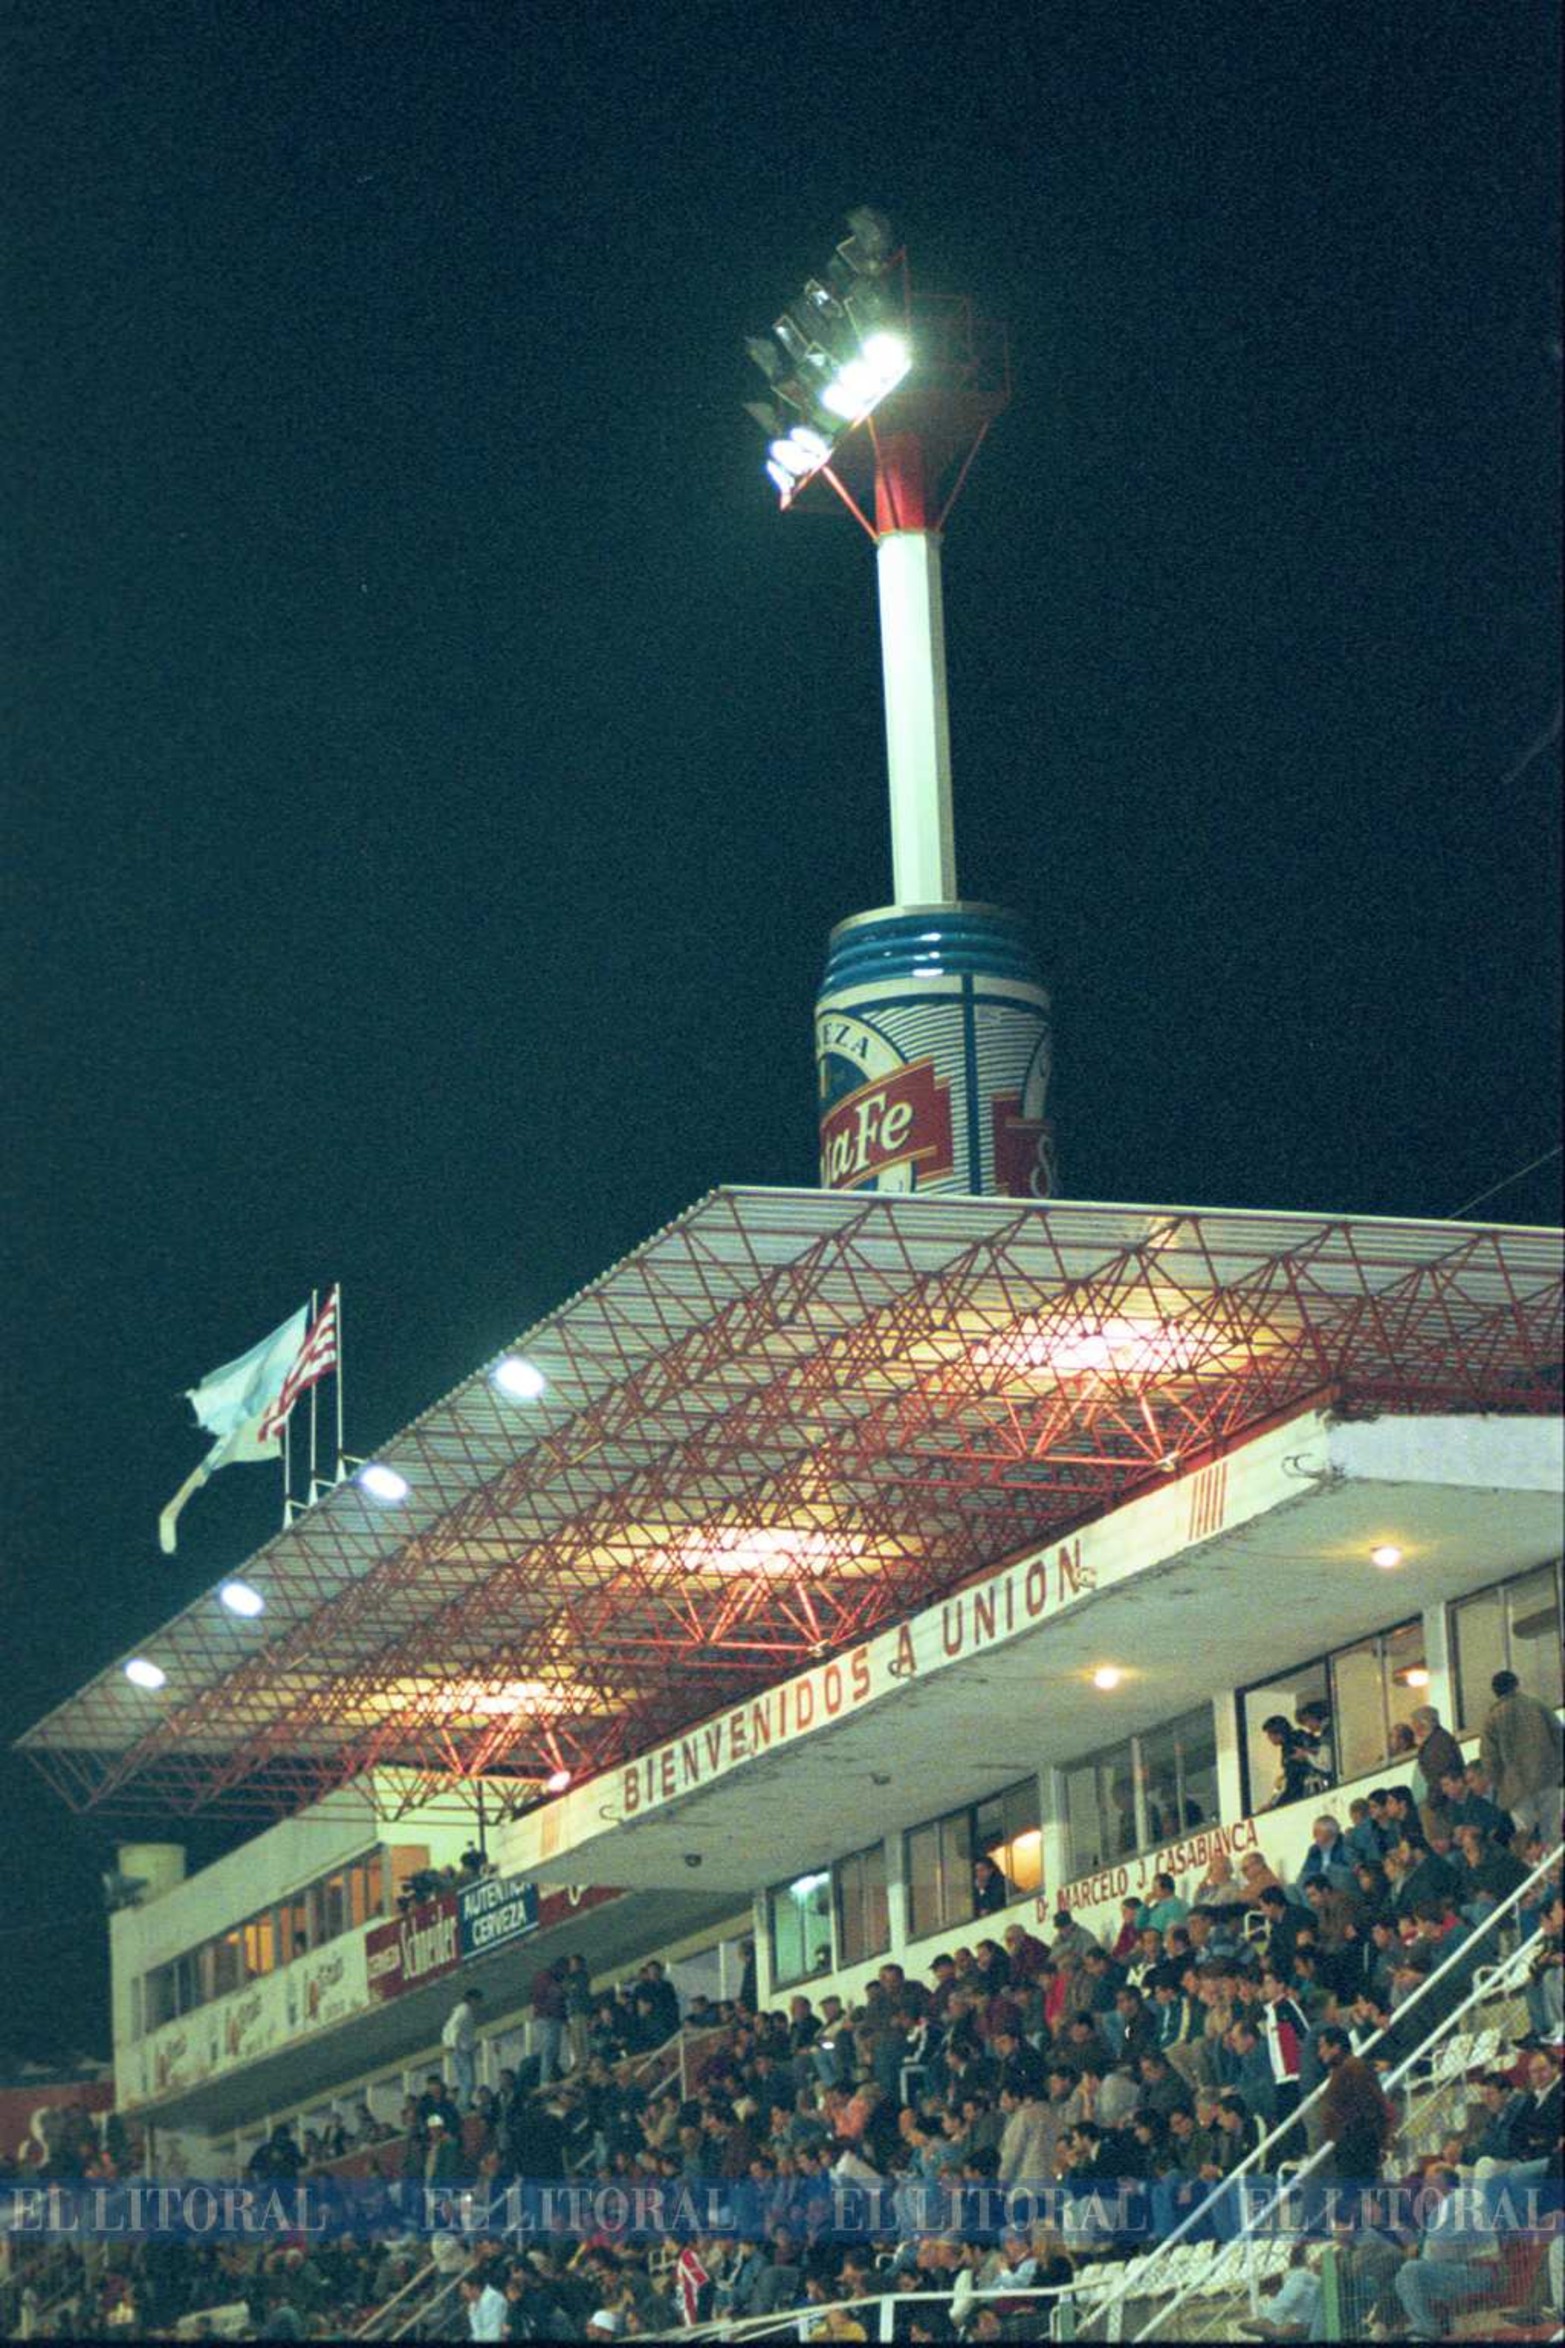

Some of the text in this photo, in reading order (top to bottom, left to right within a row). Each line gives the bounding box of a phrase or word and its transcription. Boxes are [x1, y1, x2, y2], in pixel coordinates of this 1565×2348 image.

[623, 1538, 1082, 1813] BIENVENIDOS A UNION
[1057, 1866, 1129, 1912] MARCELO
[472, 1899, 528, 1947] CERVEZA
